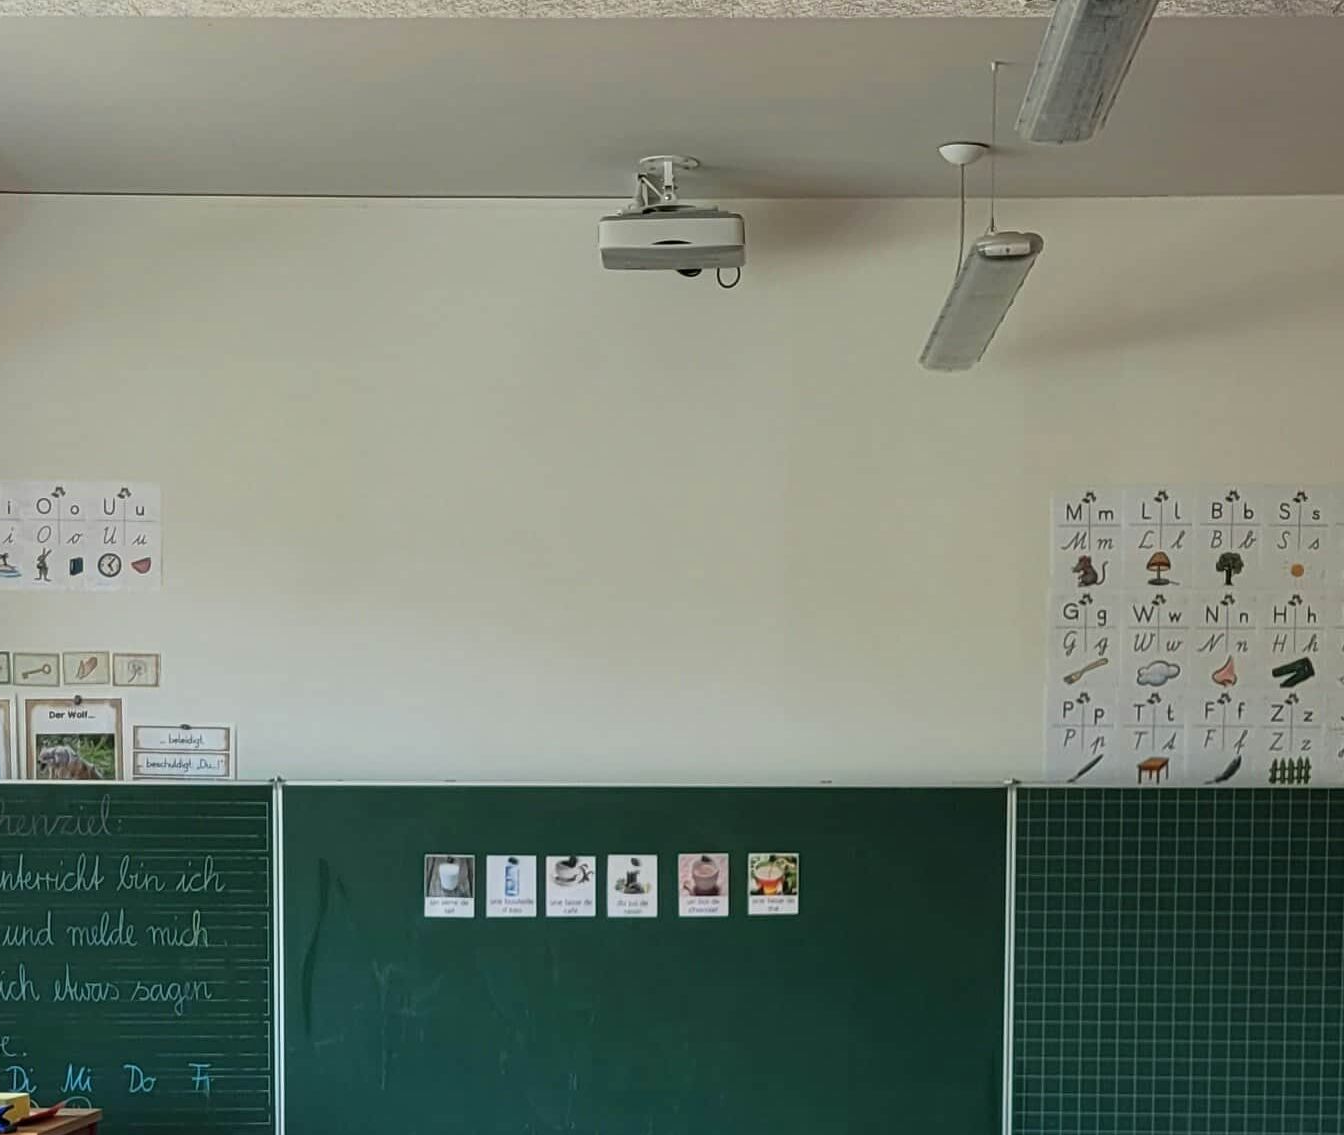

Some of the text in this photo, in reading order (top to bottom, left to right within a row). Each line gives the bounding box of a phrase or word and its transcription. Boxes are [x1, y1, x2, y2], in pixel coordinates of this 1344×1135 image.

[36, 498, 51, 514] O
[70, 505, 79, 515] o
[104, 498, 115, 515] U
[136, 506, 144, 516] u
[1067, 504, 1081, 520] M
[1099, 510, 1113, 520] m
[1142, 502, 1151, 519] L
[1212, 502, 1222, 519] B
[1244, 503, 1253, 519] b
[1280, 503, 1290, 520] S
[1312, 510, 1320, 520] s
[1063, 603, 1079, 620] G
[1097, 610, 1106, 626] g
[1133, 606, 1154, 622] W
[1169, 613, 1181, 622] w
[1206, 606, 1218, 623] N
[1240, 613, 1248, 623] n
[1274, 606, 1286, 623] H
[1308, 606, 1316, 623] h
[49, 711, 65, 719] Der
[1063, 701, 1074, 718] P
[1094, 708, 1104, 725] p
[1134, 704, 1145, 721] T
[1168, 705, 1174, 721] t
[1205, 702, 1214, 718] F
[1238, 702, 1245, 718] f
[1271, 705, 1284, 722] Z
[1304, 712, 1313, 722] z
[116, 854, 166, 891] bin
[175, 854, 225, 892] ich
[2, 910, 55, 947] und
[67, 908, 137, 947] melde
[53, 962, 120, 1002] etwas
[130, 981, 212, 1016] sagen
[6, 1066, 37, 1094] Di
[60, 1063, 93, 1093] Mi
[123, 1063, 156, 1093] Do
